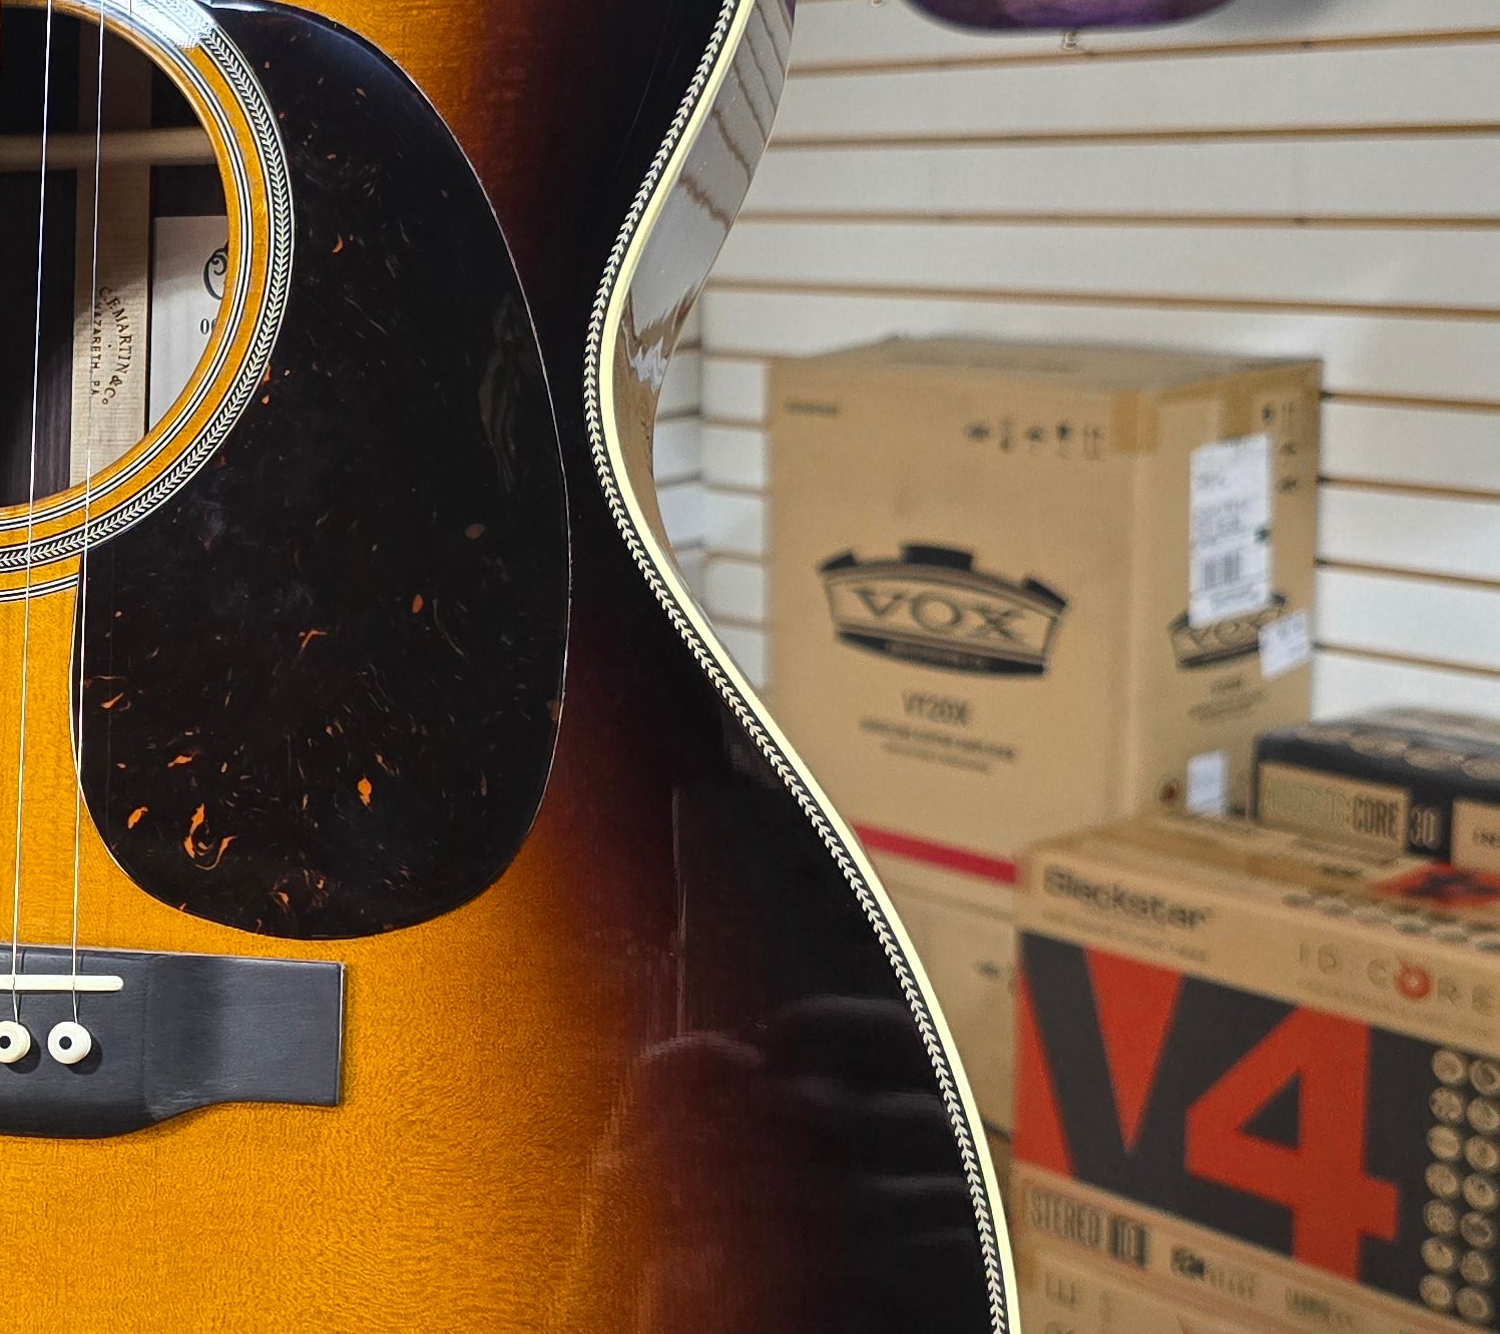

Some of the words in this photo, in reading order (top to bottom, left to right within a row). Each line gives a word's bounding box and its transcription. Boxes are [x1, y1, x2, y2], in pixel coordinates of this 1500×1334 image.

[851, 586, 1030, 645] VOX
[1044, 864, 1208, 932] Blackstar
[1019, 929, 1398, 1283] V4
